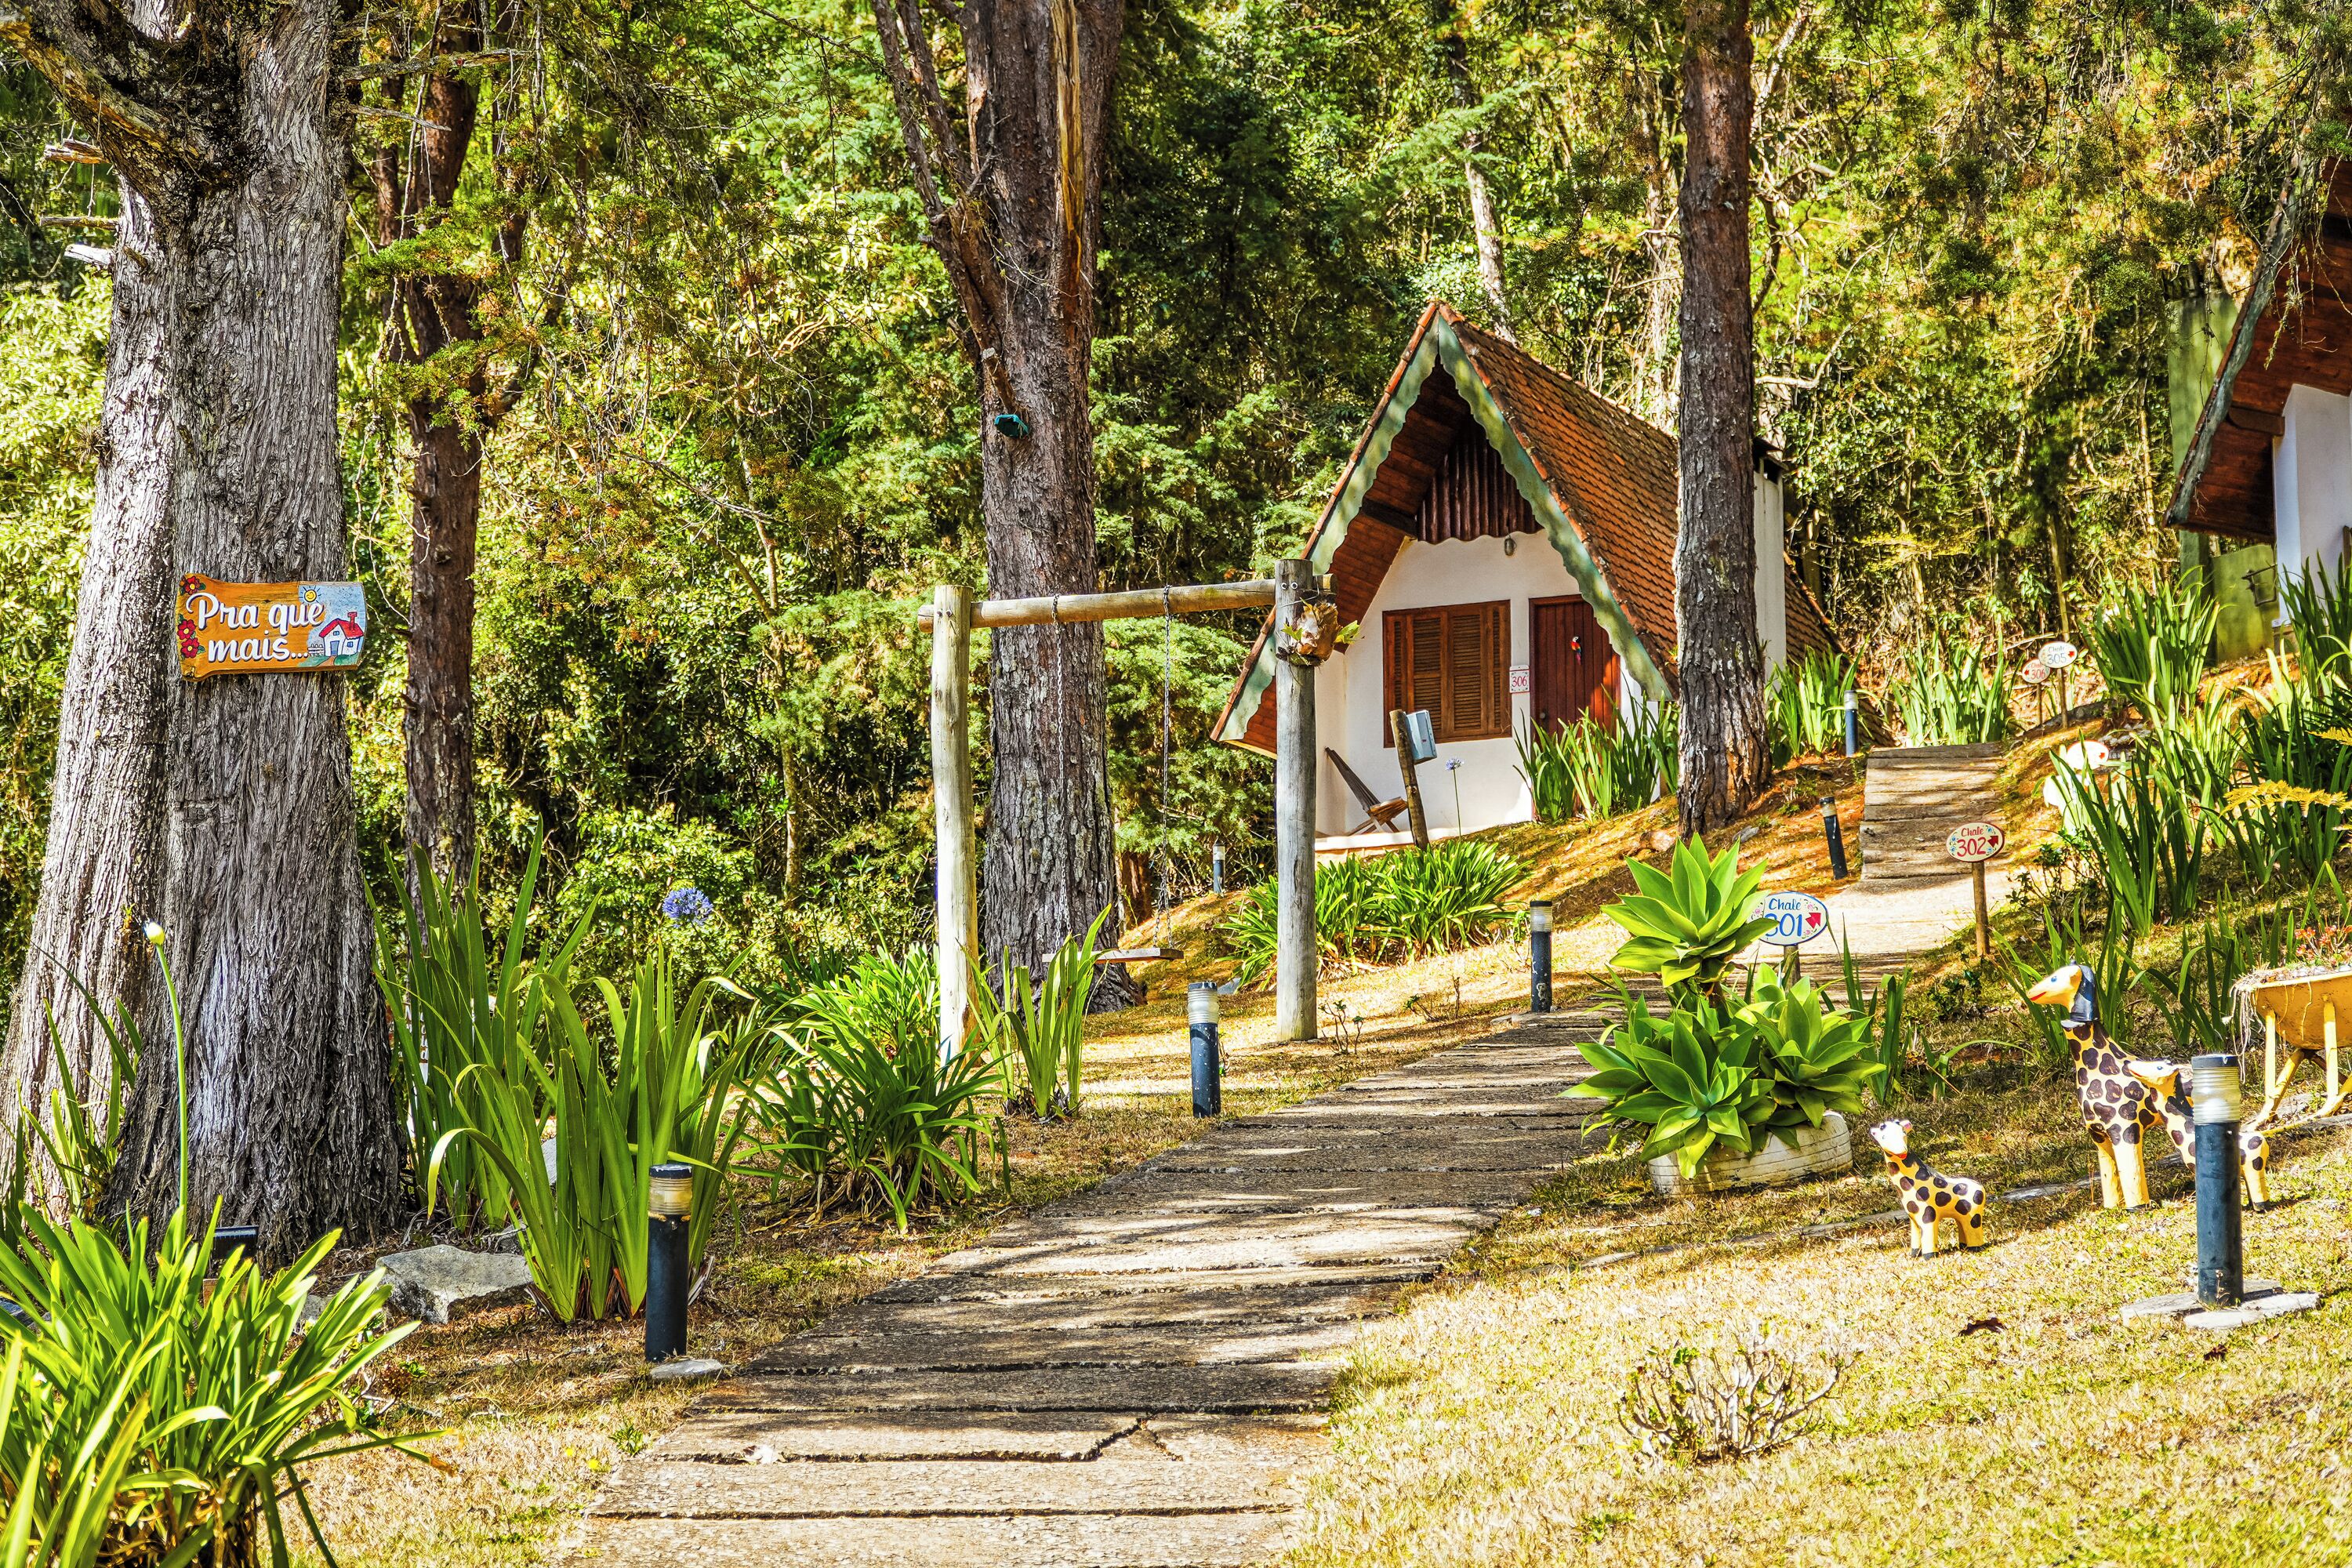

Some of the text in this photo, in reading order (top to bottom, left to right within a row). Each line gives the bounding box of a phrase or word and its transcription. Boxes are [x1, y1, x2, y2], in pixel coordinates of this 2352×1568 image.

[186, 592, 324, 637] Pra que
[208, 630, 309, 662] mais...
[2047, 652, 2067, 665] 305
[1512, 676, 1527, 688] 306
[2031, 669, 2046, 680] 306
[1957, 837, 1986, 857] 302
